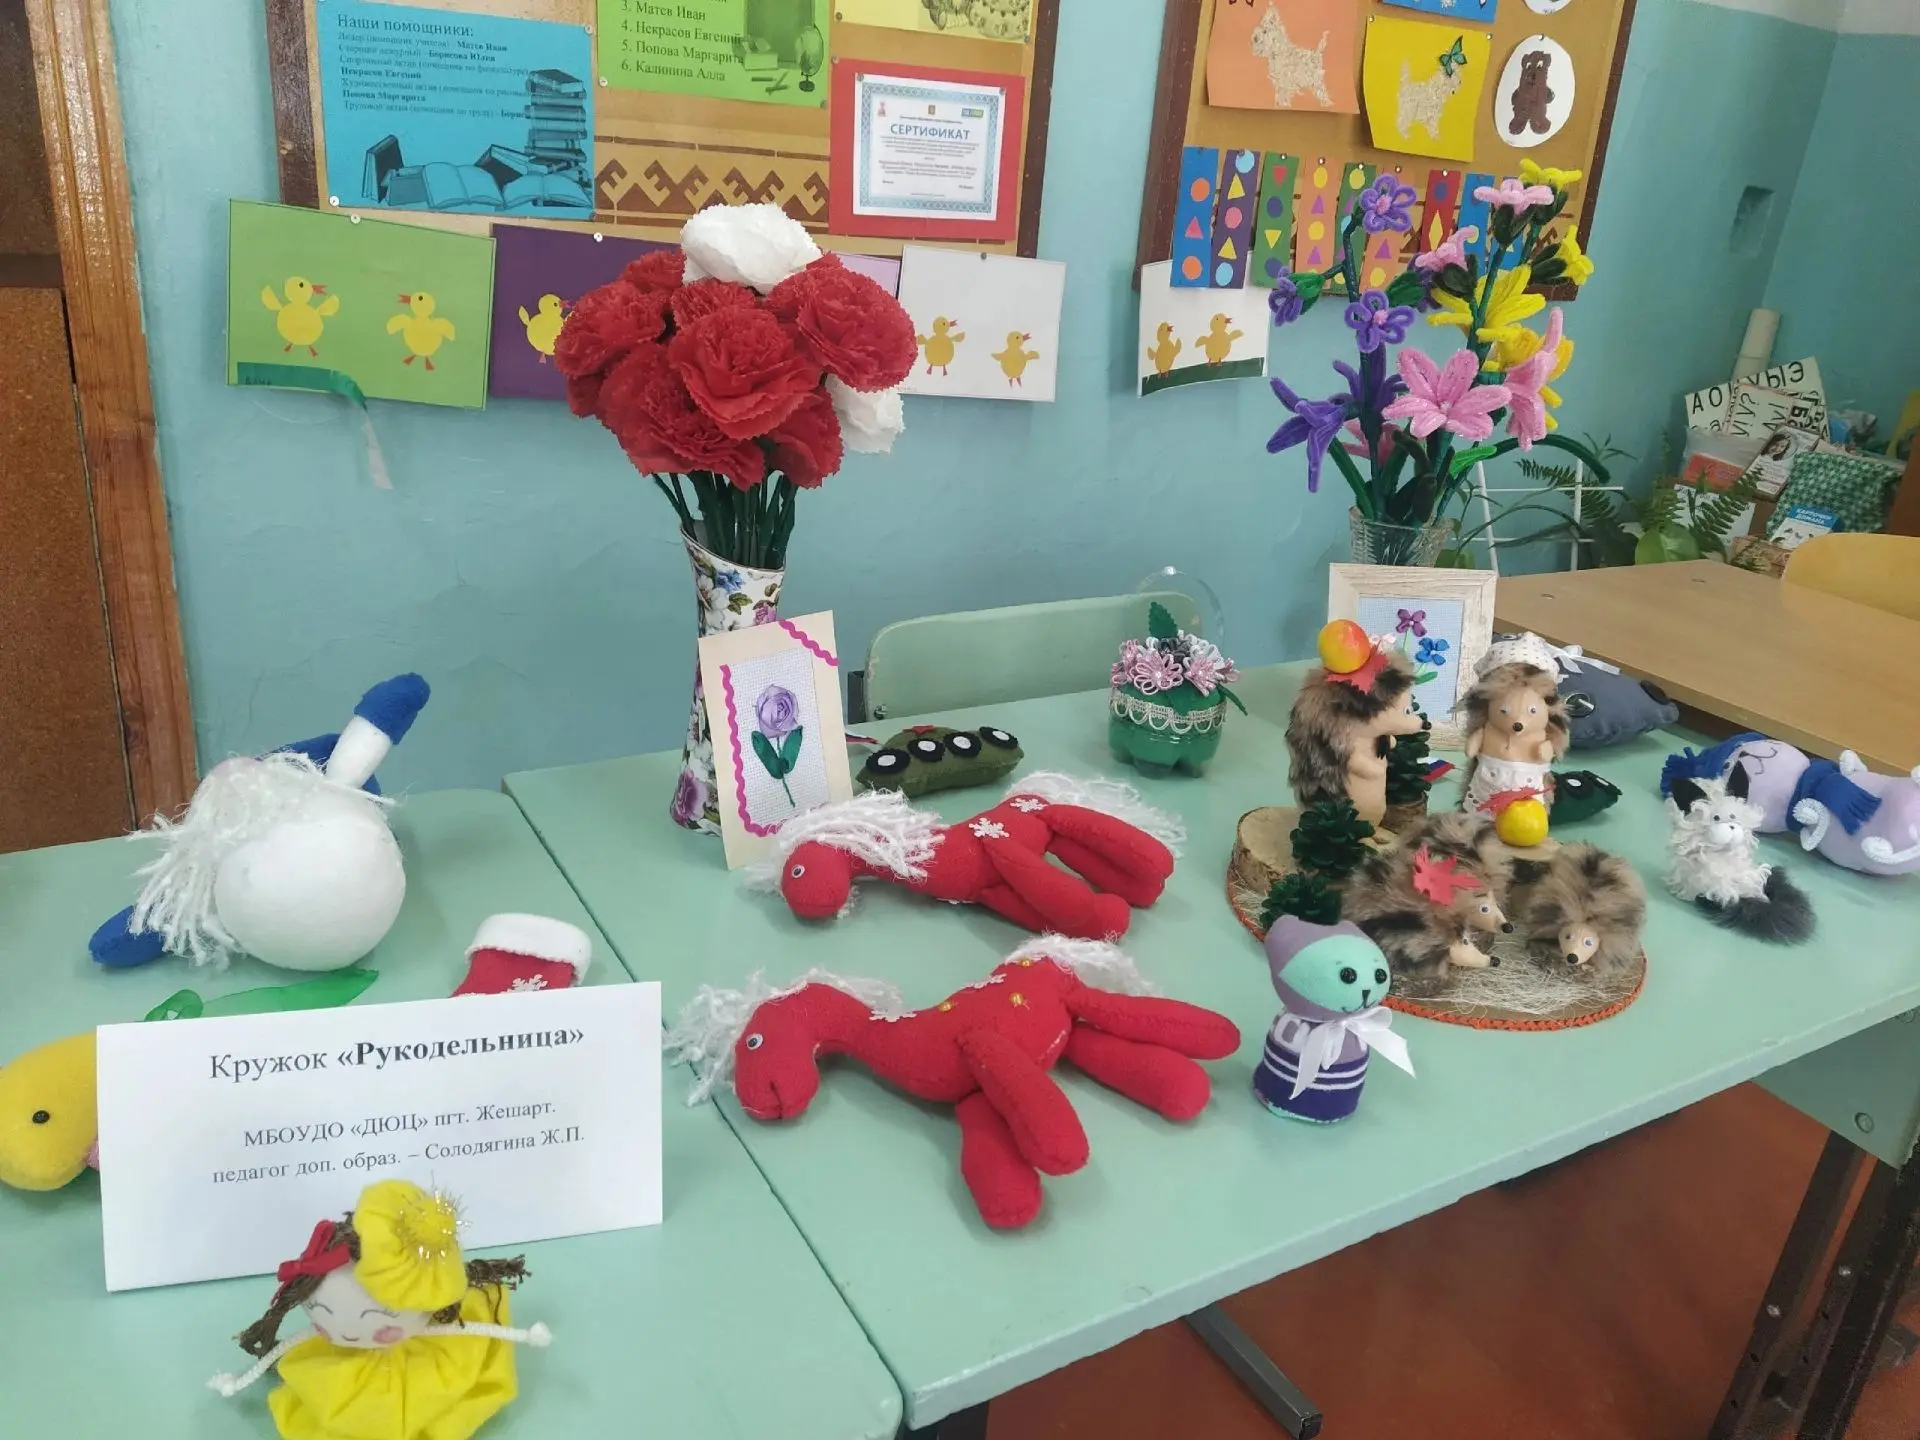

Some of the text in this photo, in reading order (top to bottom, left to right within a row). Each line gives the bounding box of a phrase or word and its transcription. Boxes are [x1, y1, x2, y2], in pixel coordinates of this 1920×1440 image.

[636, 1, 673, 16] Матев
[677, 6, 706, 21] Иван
[337, 13, 474, 37] Наши помощники:
[621, 20, 632, 32] 4.
[636, 21, 691, 38] Некрасов
[621, 39, 632, 52] 5.
[636, 41, 679, 57] Попова
[621, 59, 726, 81] 6. Калинина Алла
[890, 123, 970, 140] СЕРТИФИКАТ
[209, 1028, 584, 1084] Кружок «Рукодельница»
[243, 1101, 556, 1147] МБОУДО «ДЮЦ» пгт. Жешарт.
[212, 1163, 290, 1184] педагог
[295, 1159, 336, 1177] доп.
[343, 1151, 401, 1171] образ.
[425, 1135, 535, 1160] Солодягина
[541, 1125, 585, 1146] Ж.П.
